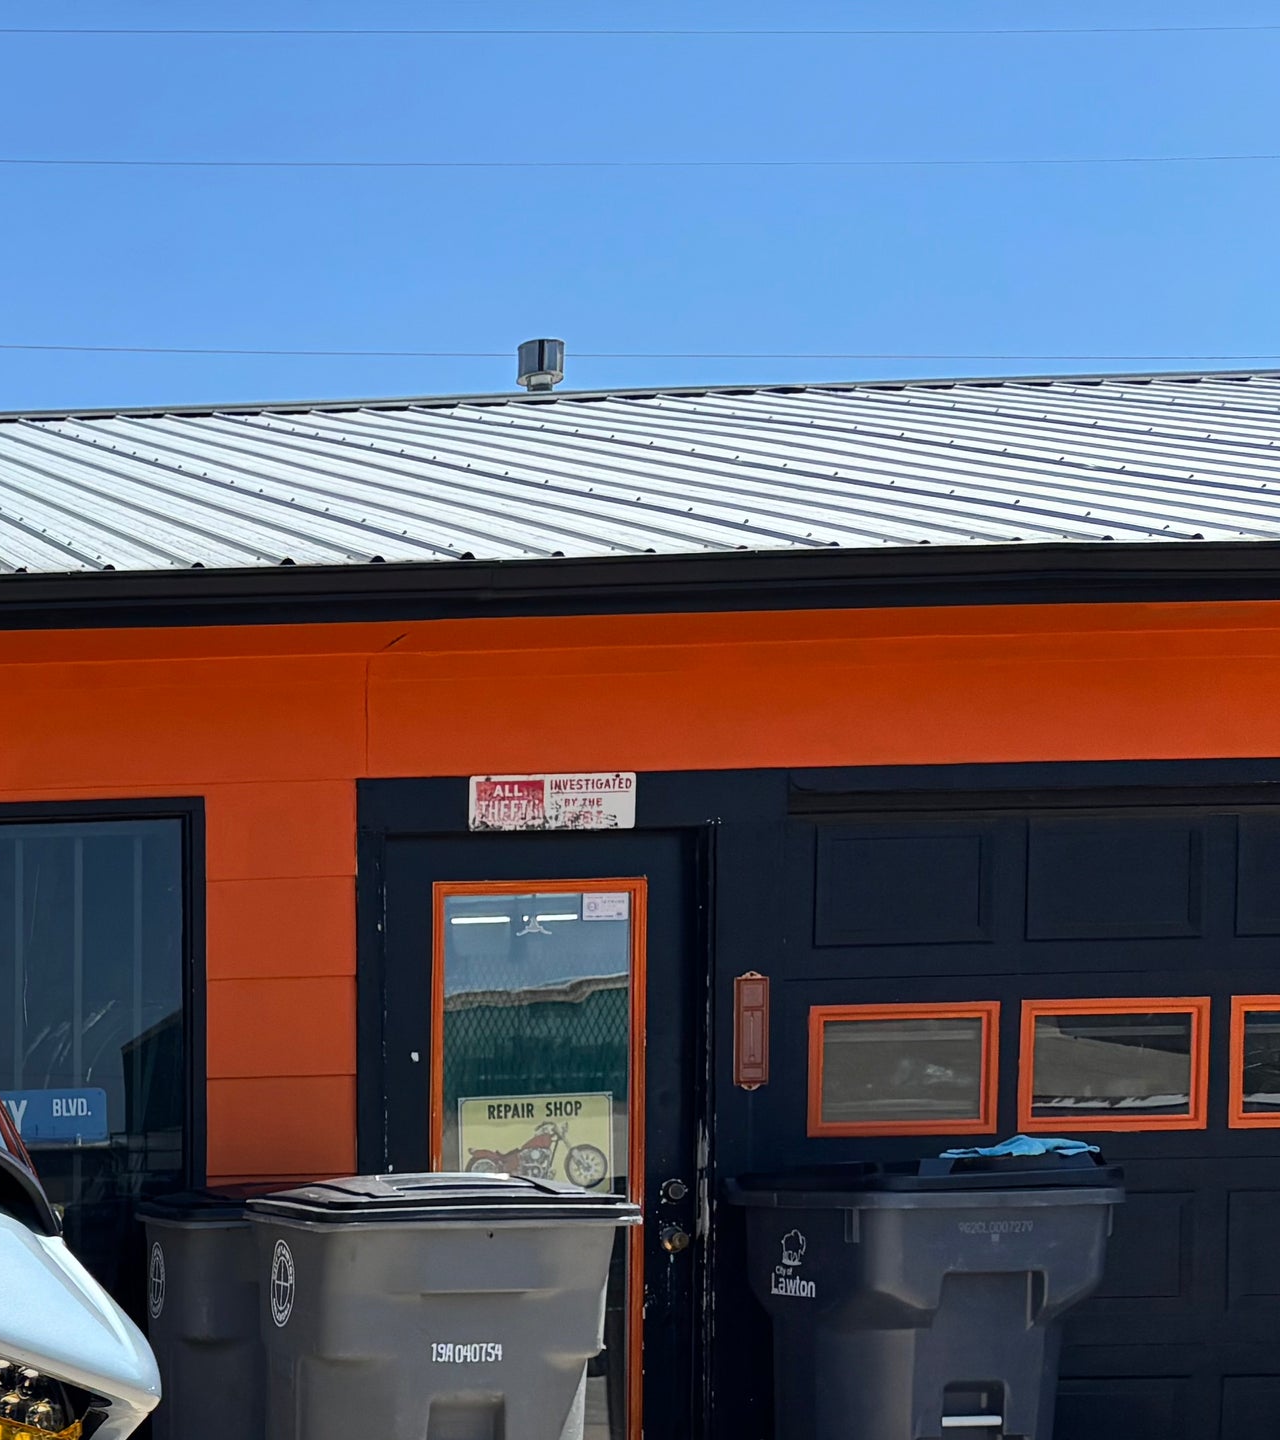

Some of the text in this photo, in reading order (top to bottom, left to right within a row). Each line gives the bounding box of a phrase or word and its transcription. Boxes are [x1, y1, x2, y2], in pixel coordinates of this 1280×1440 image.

[493, 784, 523, 797] ALL
[550, 778, 632, 790] INVESTIGATED
[564, 798, 578, 807] BY
[52, 1098, 92, 1117] BLVD.
[487, 1100, 582, 1120] REPAIR SHOP
[771, 1272, 816, 1298] Lawton
